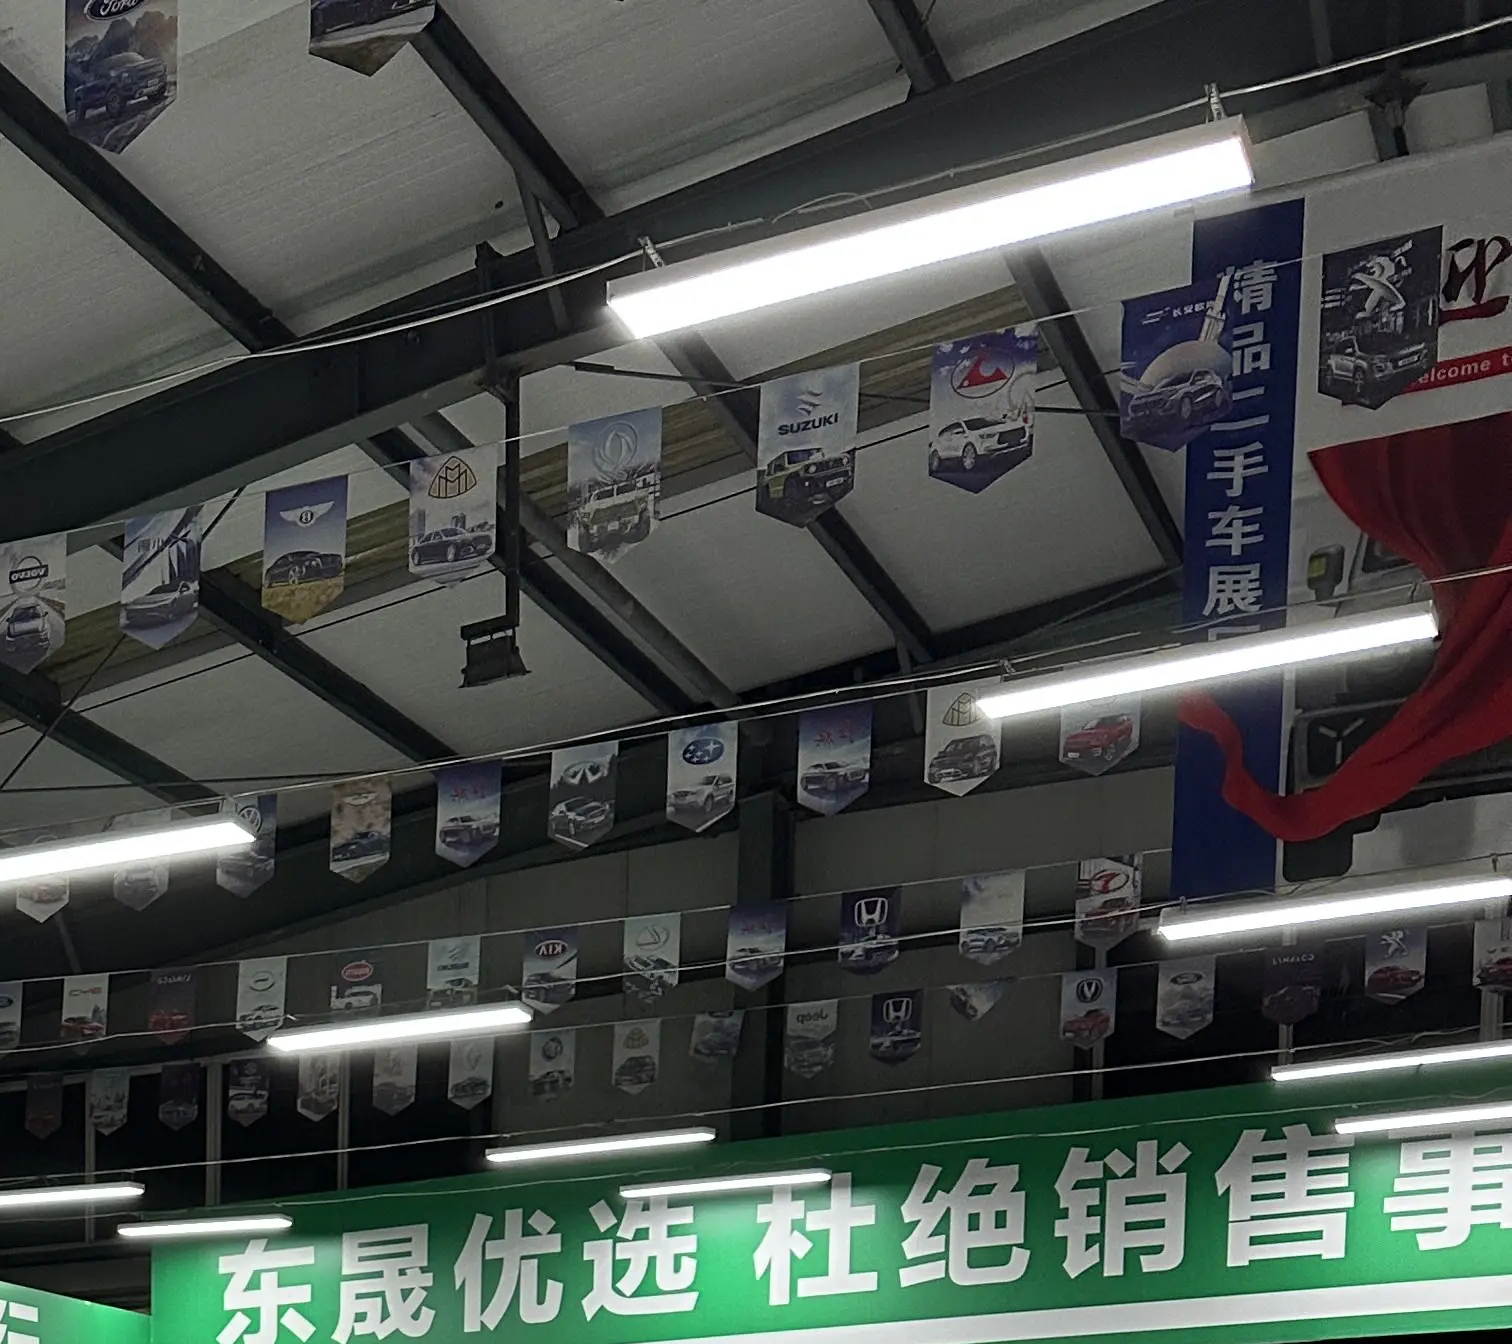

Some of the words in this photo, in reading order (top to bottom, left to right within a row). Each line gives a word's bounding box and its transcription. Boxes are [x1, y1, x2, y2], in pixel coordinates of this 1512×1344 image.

[1418, 357, 1491, 384] elcome
[777, 412, 839, 436] SUZUKI
[1202, 259, 1278, 641] 精品二手车展
